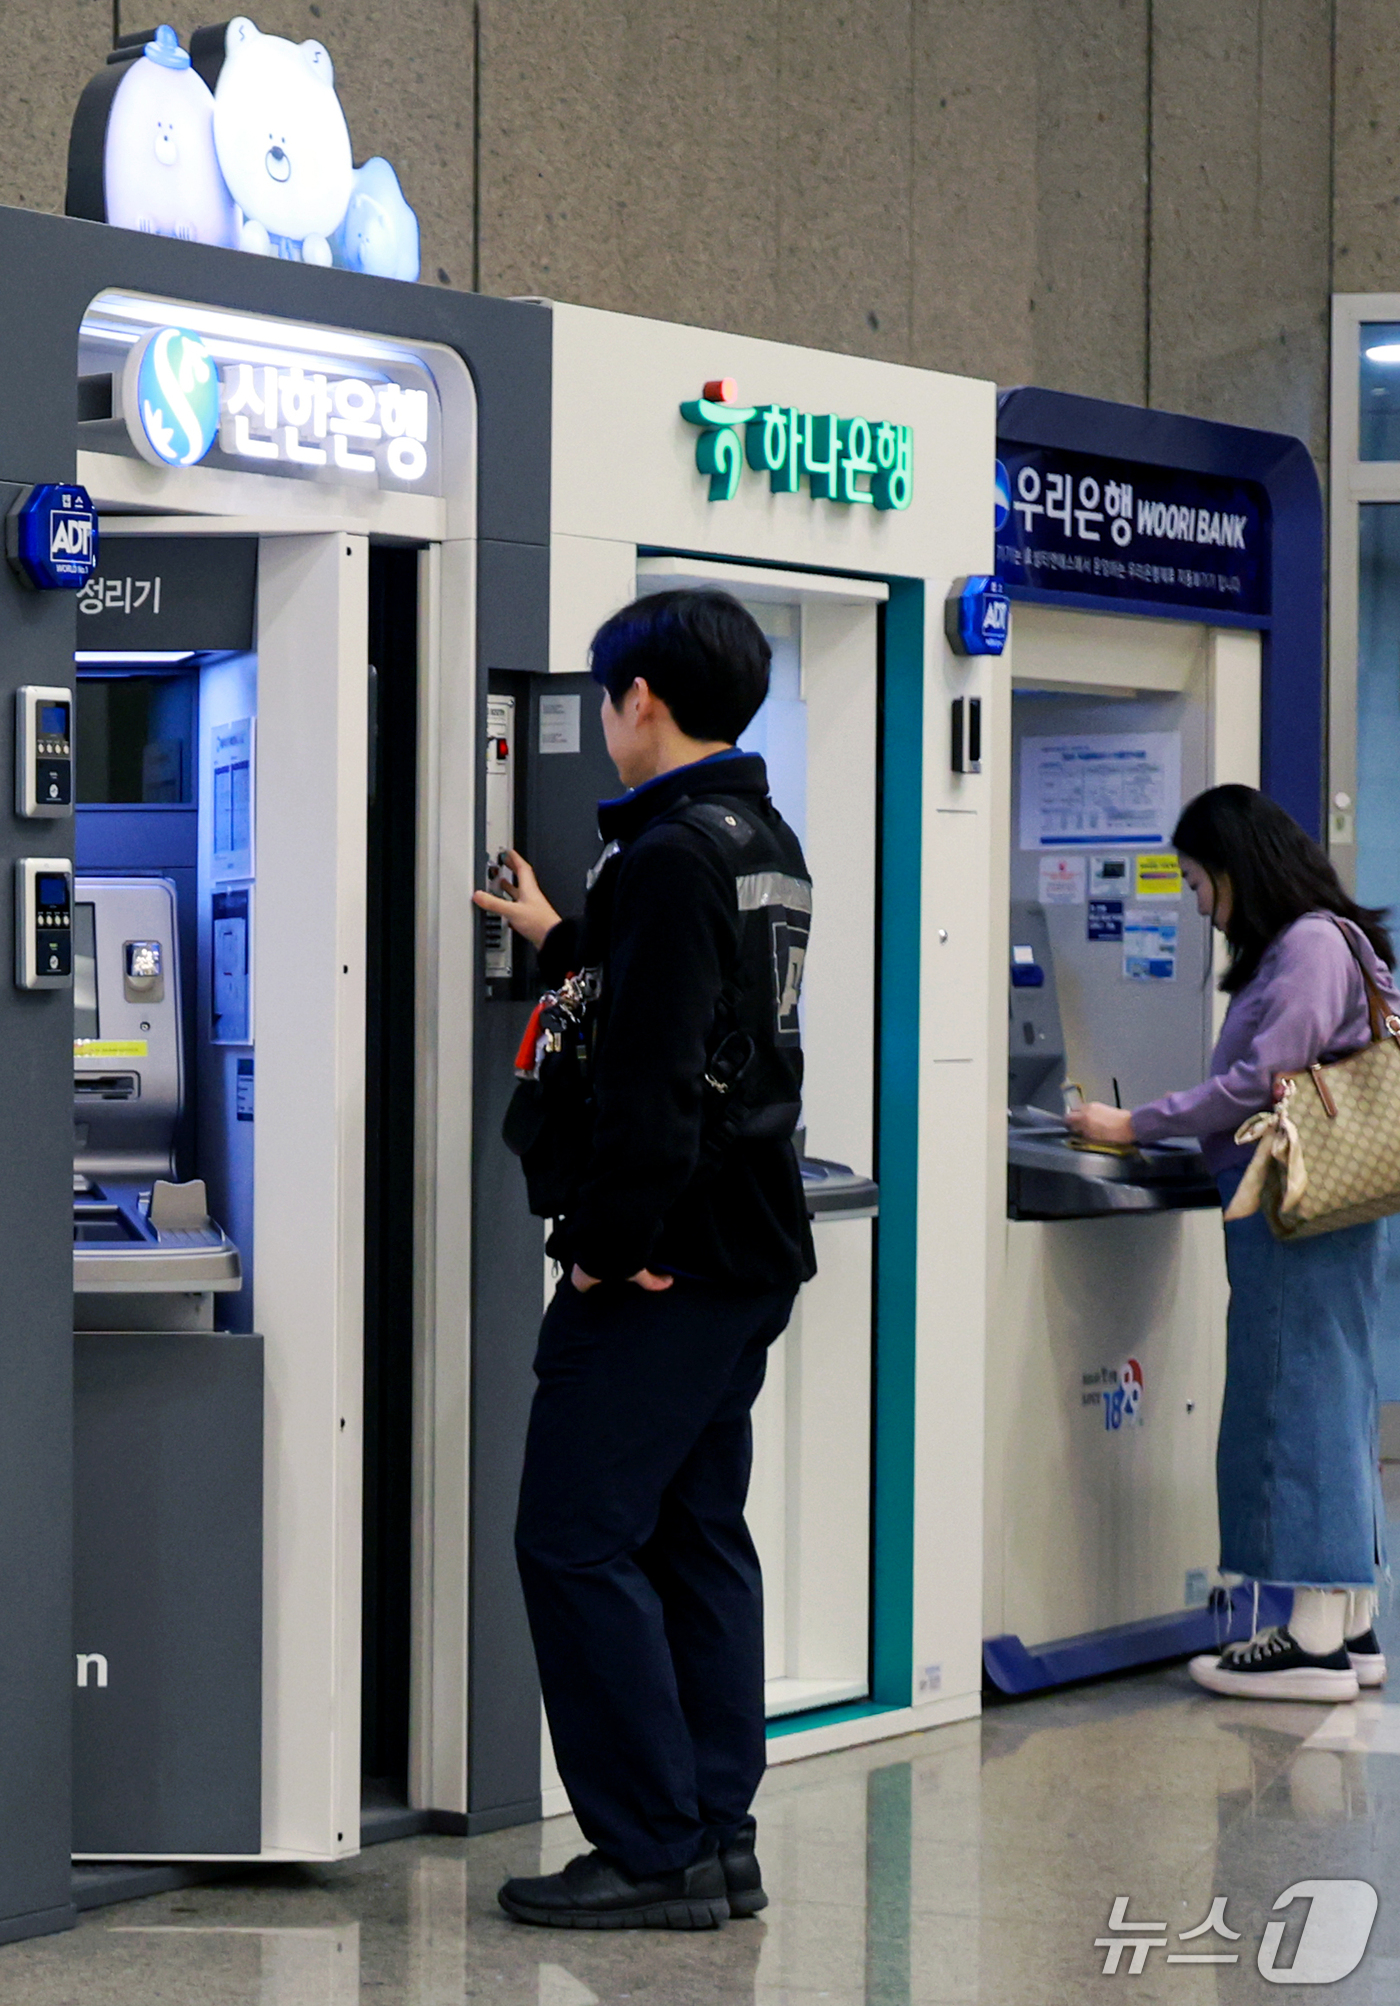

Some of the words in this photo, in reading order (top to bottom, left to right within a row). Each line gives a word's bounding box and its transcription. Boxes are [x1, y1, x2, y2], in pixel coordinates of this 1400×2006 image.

[226, 362, 429, 481] 신한은행
[763, 403, 914, 511] 하나은행
[1013, 466, 1134, 547] 우리은행
[1136, 499, 1197, 542] WOORI
[1196, 509, 1248, 550] BANK
[51, 520, 92, 556] ADT
[56, 563, 77, 574] WORLD
[983, 600, 1008, 630] ADT
